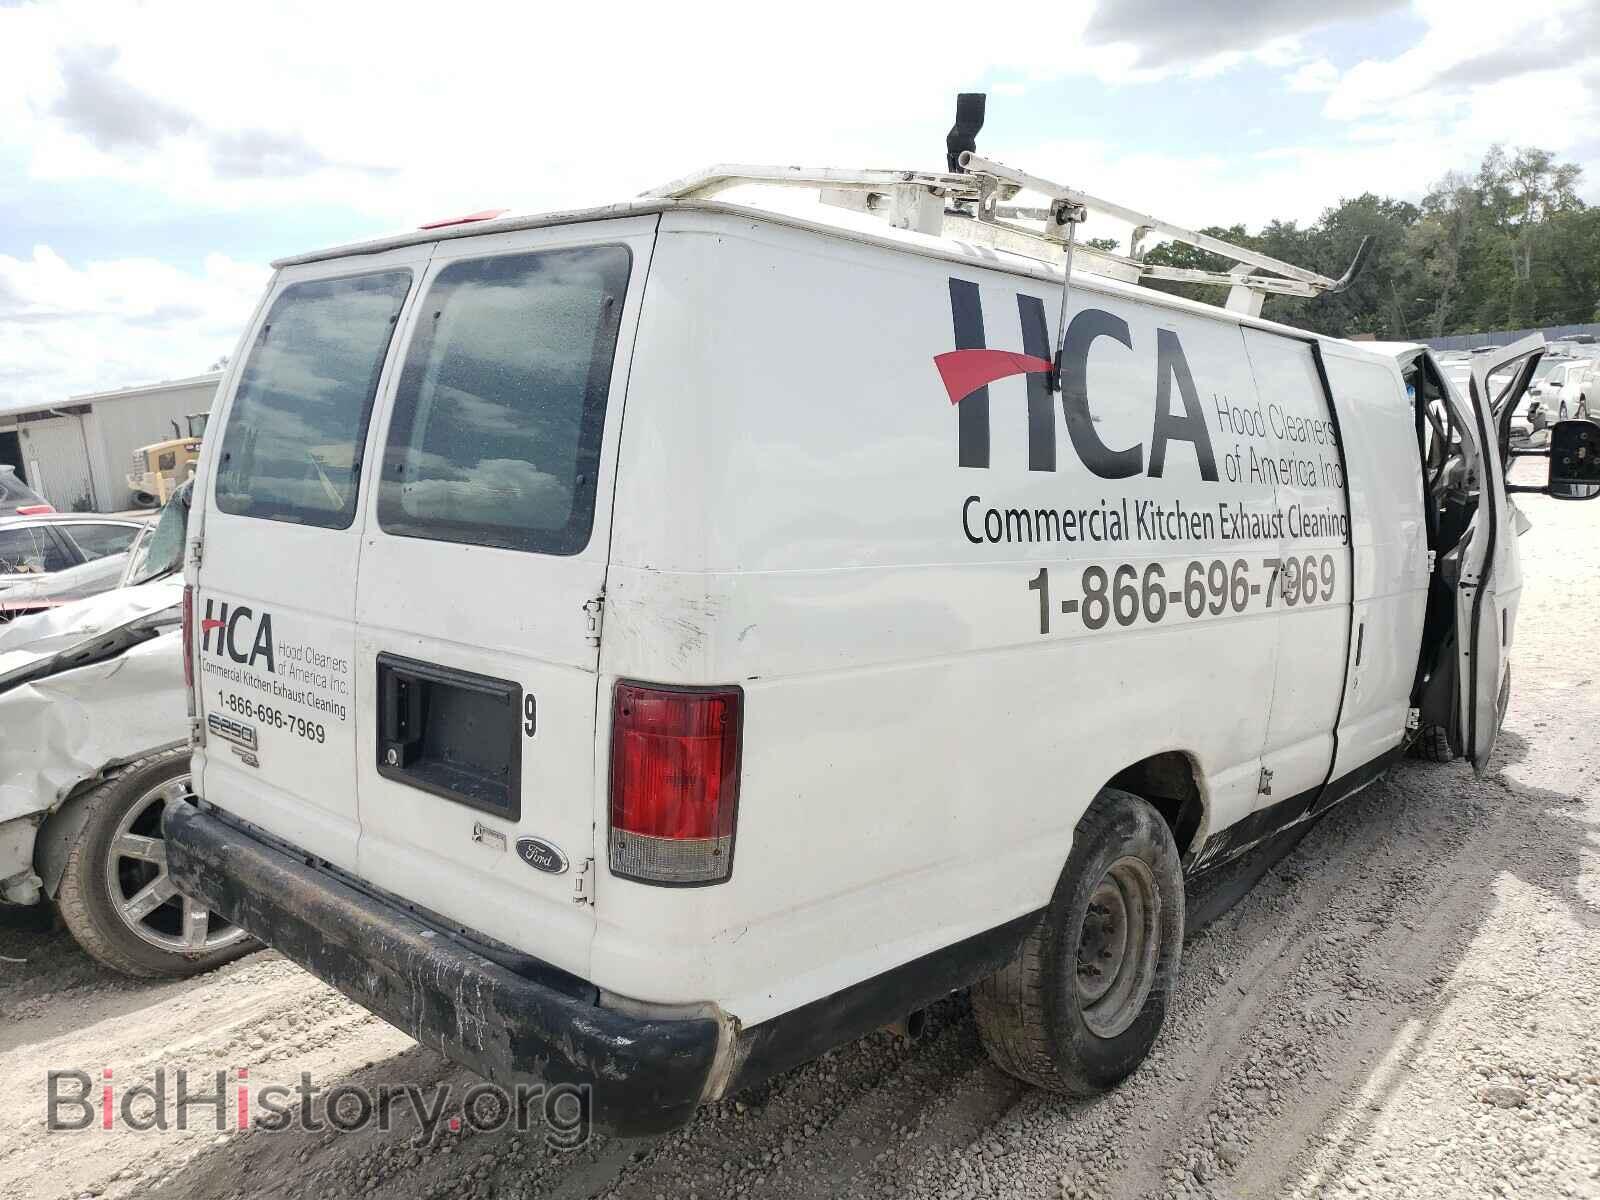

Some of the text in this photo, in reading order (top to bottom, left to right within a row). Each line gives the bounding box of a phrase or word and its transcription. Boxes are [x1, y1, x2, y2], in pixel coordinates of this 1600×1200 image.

[933, 277, 1219, 482] HCA
[1213, 393, 1338, 447] Hood Cleaners
[1225, 444, 1242, 483] of
[1249, 446, 1317, 488] America
[962, 496, 1349, 545] Commercial Kitchen Exhaust Cleaning
[1028, 554, 1336, 635] 1-866-696-7969
[202, 598, 276, 674] HCA
[279, 640, 348, 674] Hood Cleaners
[202, 657, 346, 721] Commercial Kitchen Exhaust Cleaning
[278, 661, 287, 677] of
[289, 662, 327, 689] America
[218, 688, 326, 744] 1-866-696-7969
[524, 693, 537, 738] 9
[525, 843, 554, 869] Ford
